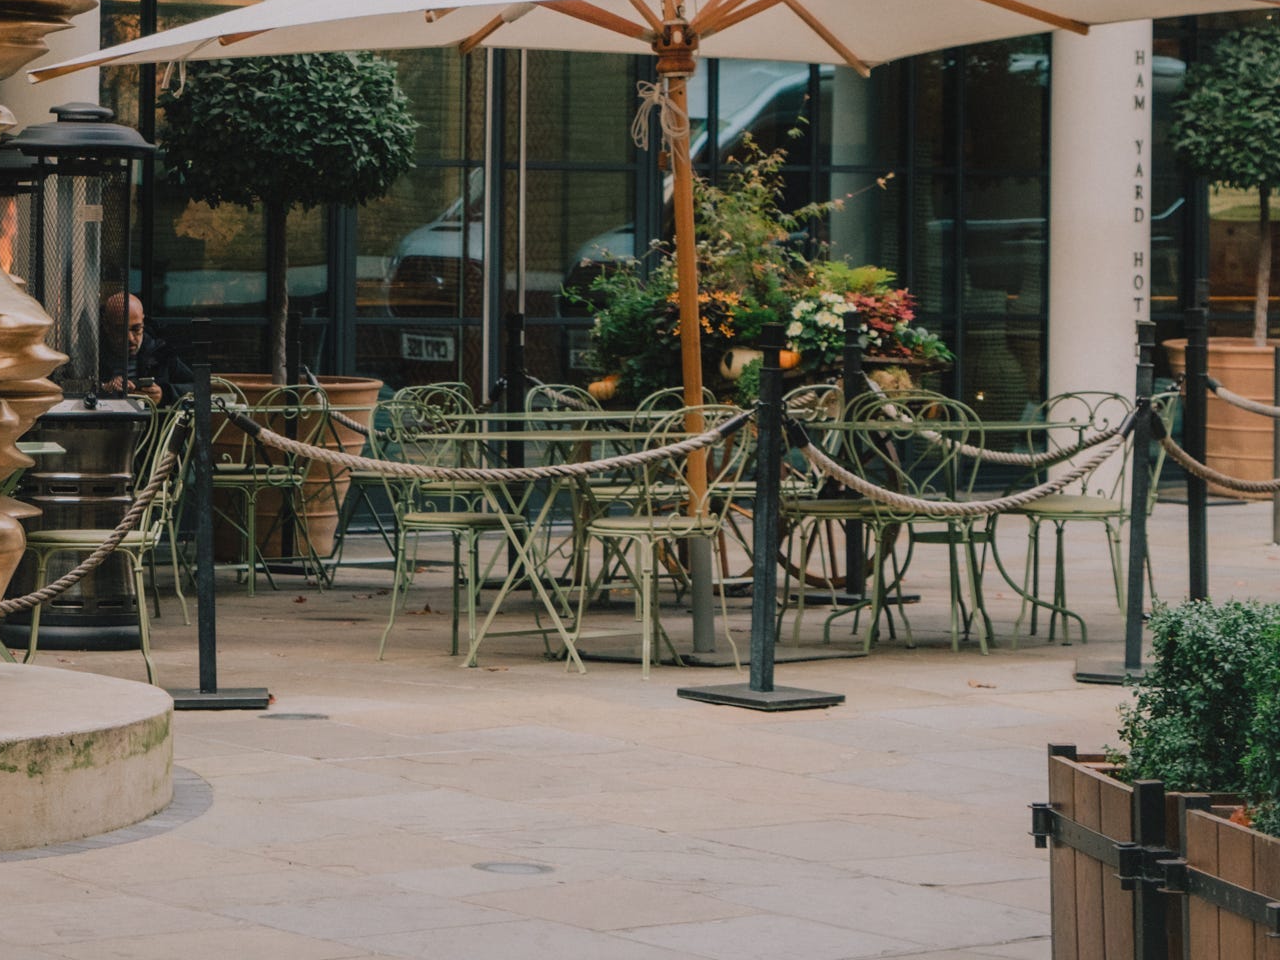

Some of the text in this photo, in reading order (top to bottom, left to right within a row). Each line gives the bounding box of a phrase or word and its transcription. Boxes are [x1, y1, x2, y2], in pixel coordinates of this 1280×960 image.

[1132, 49, 1145, 357] HAM YARD HOT
